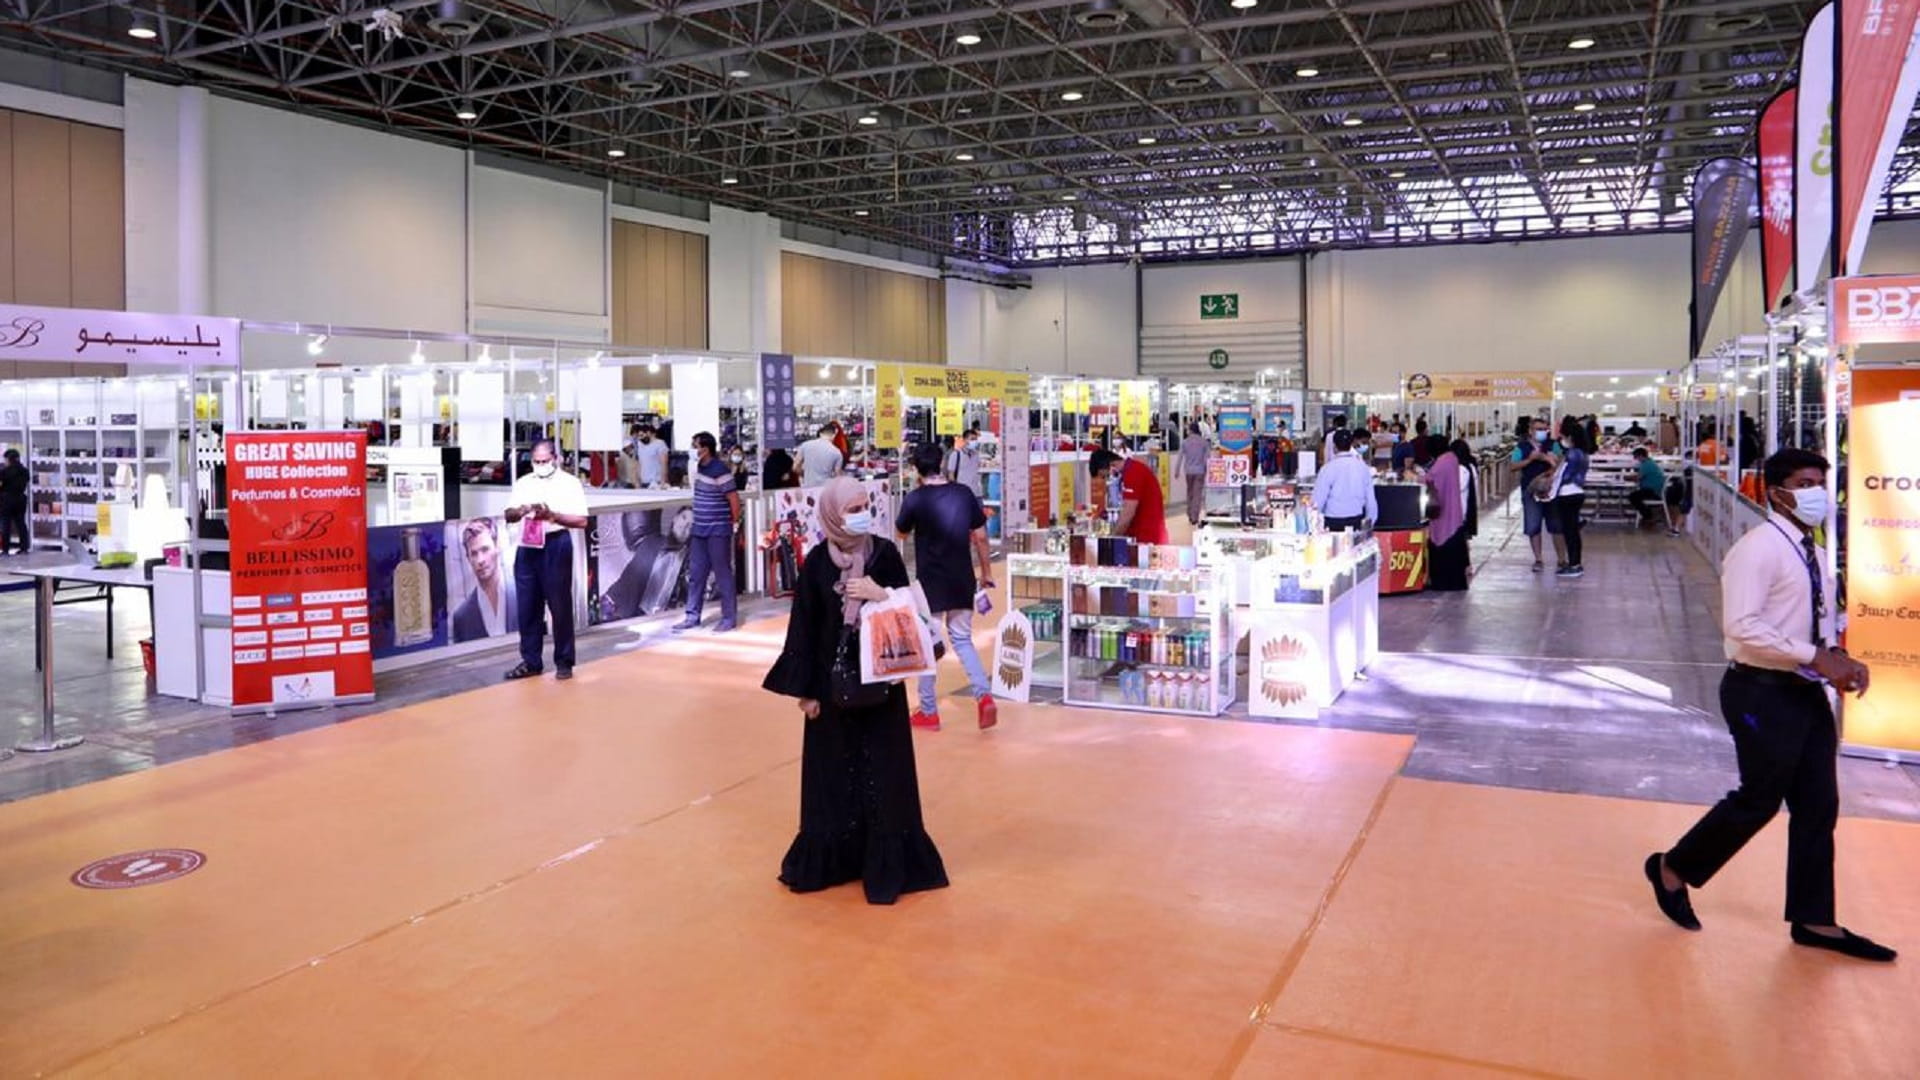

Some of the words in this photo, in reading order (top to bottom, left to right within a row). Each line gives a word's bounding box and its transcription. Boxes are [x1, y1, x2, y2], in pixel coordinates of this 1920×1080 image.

[1810, 104, 1832, 177] Cr
[235, 443, 289, 462] GREAT
[292, 441, 356, 460] SAVING
[245, 466, 279, 480] HUGE
[281, 464, 348, 478] Collection
[1864, 475, 1920, 491] cro
[231, 488, 287, 501] Perfumes
[289, 487, 297, 498] &
[301, 485, 361, 498] Cosmetics
[246, 547, 354, 565] BELLISSIMO
